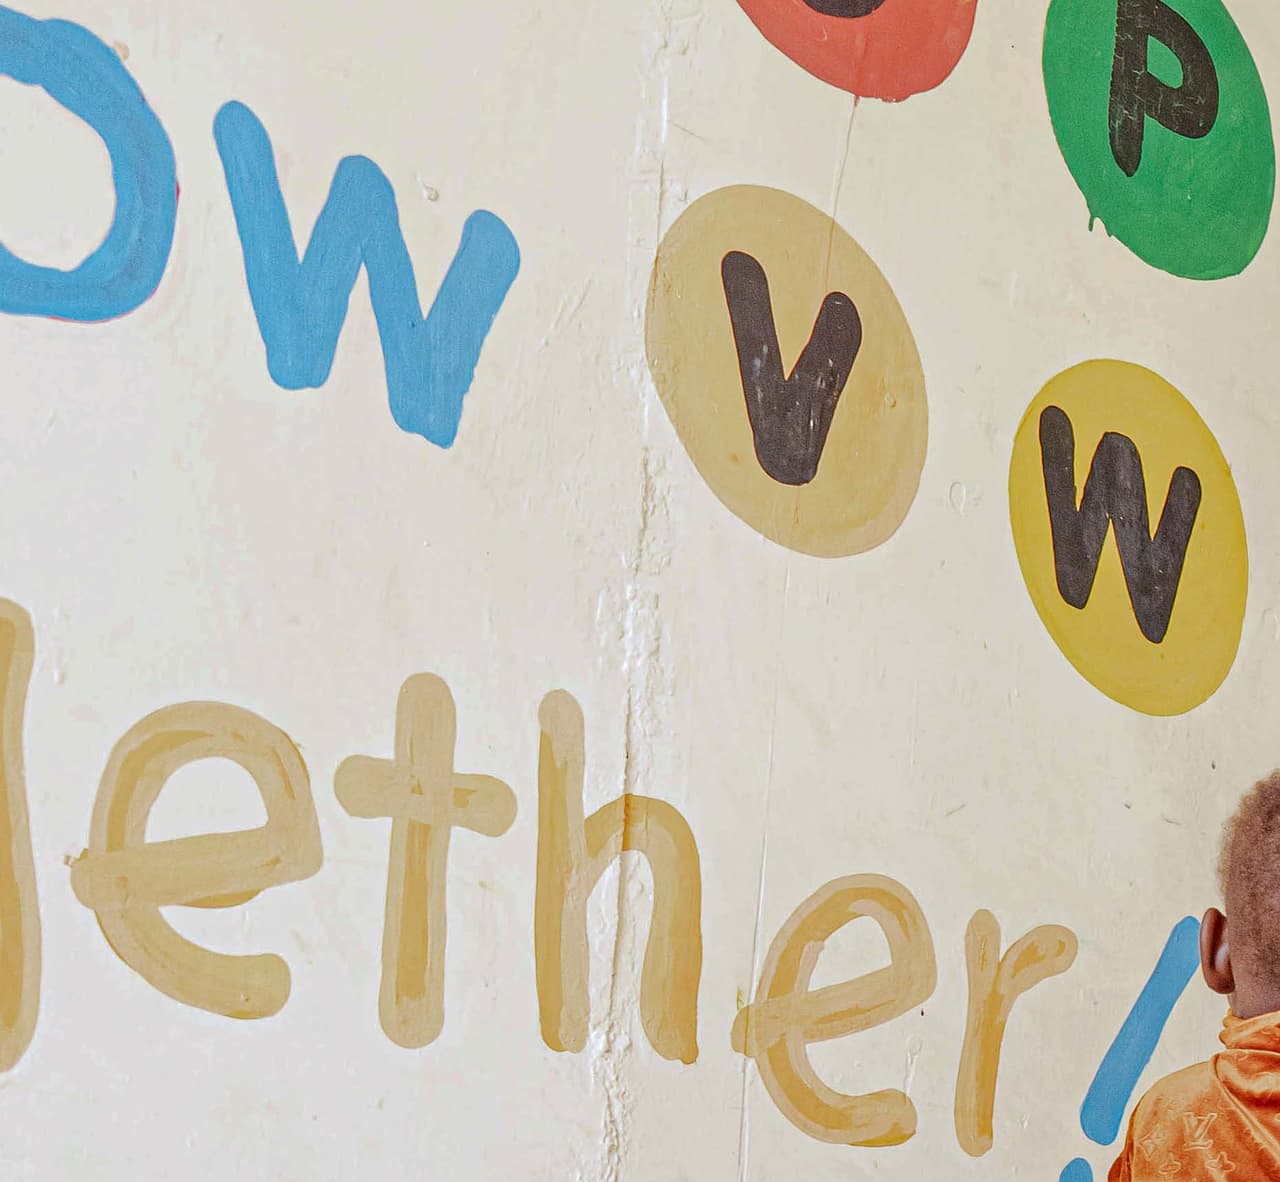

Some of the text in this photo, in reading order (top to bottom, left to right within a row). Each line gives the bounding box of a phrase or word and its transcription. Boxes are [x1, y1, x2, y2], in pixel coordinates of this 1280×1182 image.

[1108, 0, 1219, 177] P
[722, 251, 862, 485] V
[1039, 406, 1201, 643] W
